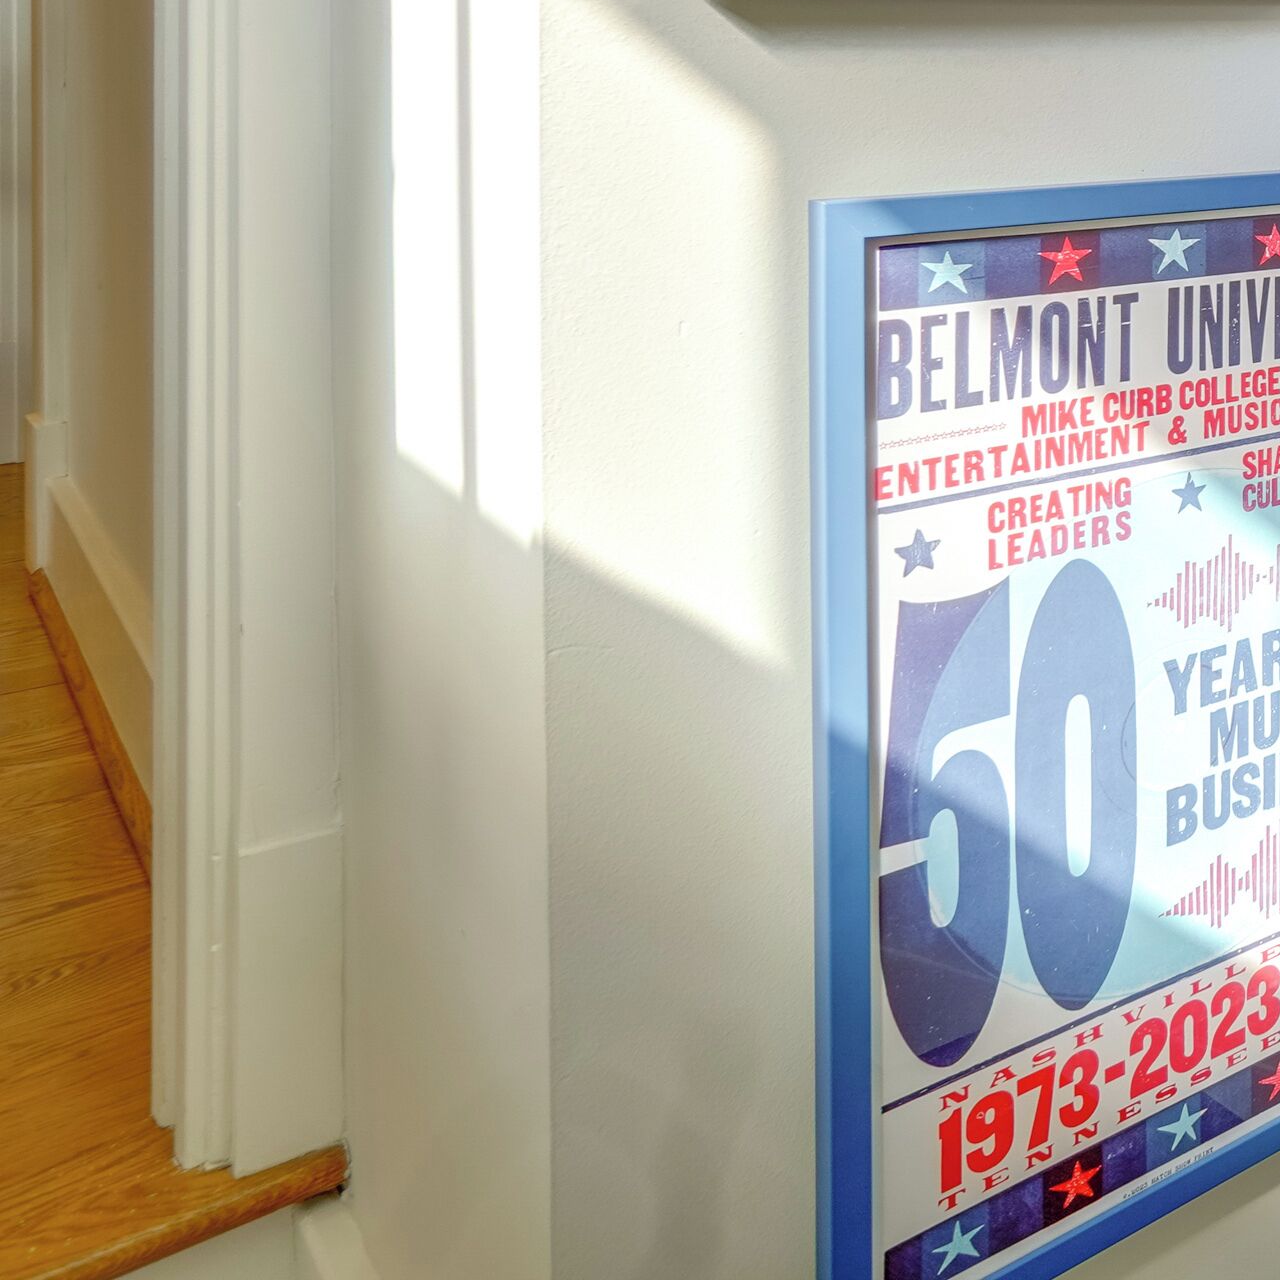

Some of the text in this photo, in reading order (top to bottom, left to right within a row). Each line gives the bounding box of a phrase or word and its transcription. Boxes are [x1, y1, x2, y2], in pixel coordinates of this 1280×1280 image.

[877, 292, 1140, 422] BELMONT
[1021, 395, 1099, 439] MIKE
[1102, 383, 1172, 427] CURB
[874, 422, 1150, 502] ENTERTAINMENT
[1166, 414, 1188, 445] &
[986, 476, 1133, 536] CREATING
[986, 517, 1133, 571] LEADERS
[878, 557, 1137, 1067] 50
